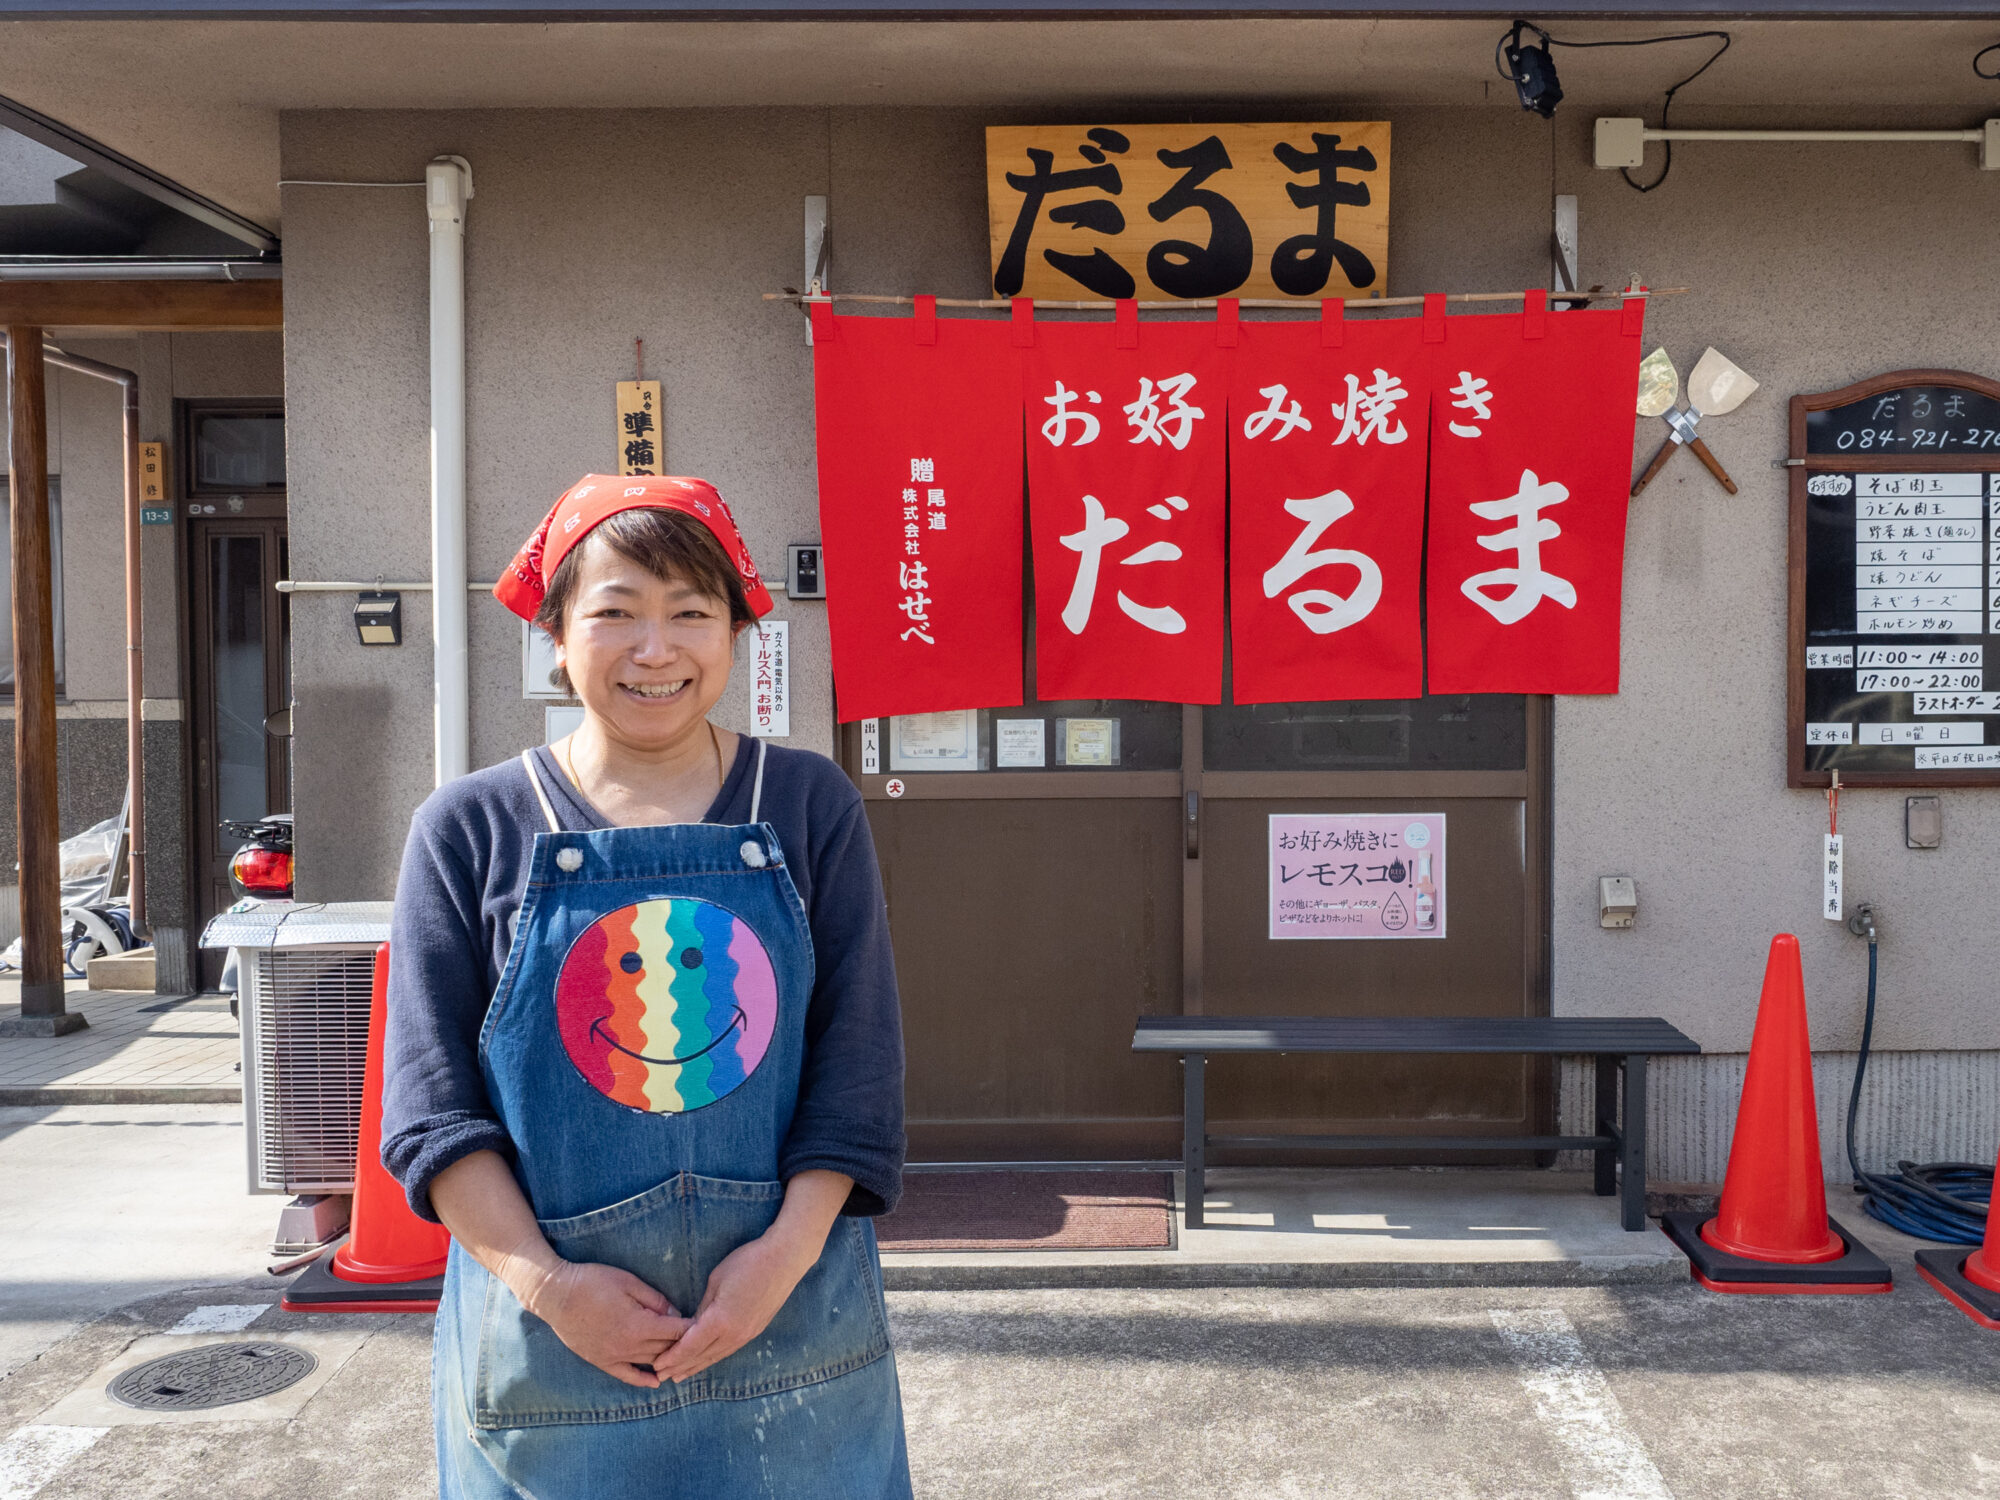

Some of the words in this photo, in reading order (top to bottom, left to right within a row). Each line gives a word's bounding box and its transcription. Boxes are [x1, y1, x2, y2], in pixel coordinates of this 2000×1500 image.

[994, 127, 1378, 299] だるま
[1872, 394, 1966, 420] だるま
[910, 458, 934, 482] 贈
[1810, 478, 1847, 494] おすすめ
[927, 489, 947, 530] 尾道
[1059, 468, 1577, 635] だるま
[1870, 547, 1942, 562] 焼そば
[1870, 571, 1943, 584] 焼うどん
[1870, 594, 1958, 608] ネギチーズ
[1869, 618, 1954, 631] ホルモン炒め
[1808, 652, 1852, 667] 営業時間
[1918, 695, 1984, 711] ラストオーダー
[1810, 729, 1849, 741] 定休日
[1881, 725, 1950, 742] 日曜日
[865, 723, 875, 768] 出入口
[889, 782, 901, 793] 犬
[1279, 829, 1399, 851] お好み焼きに
[1280, 862, 1389, 886] レモスコ
